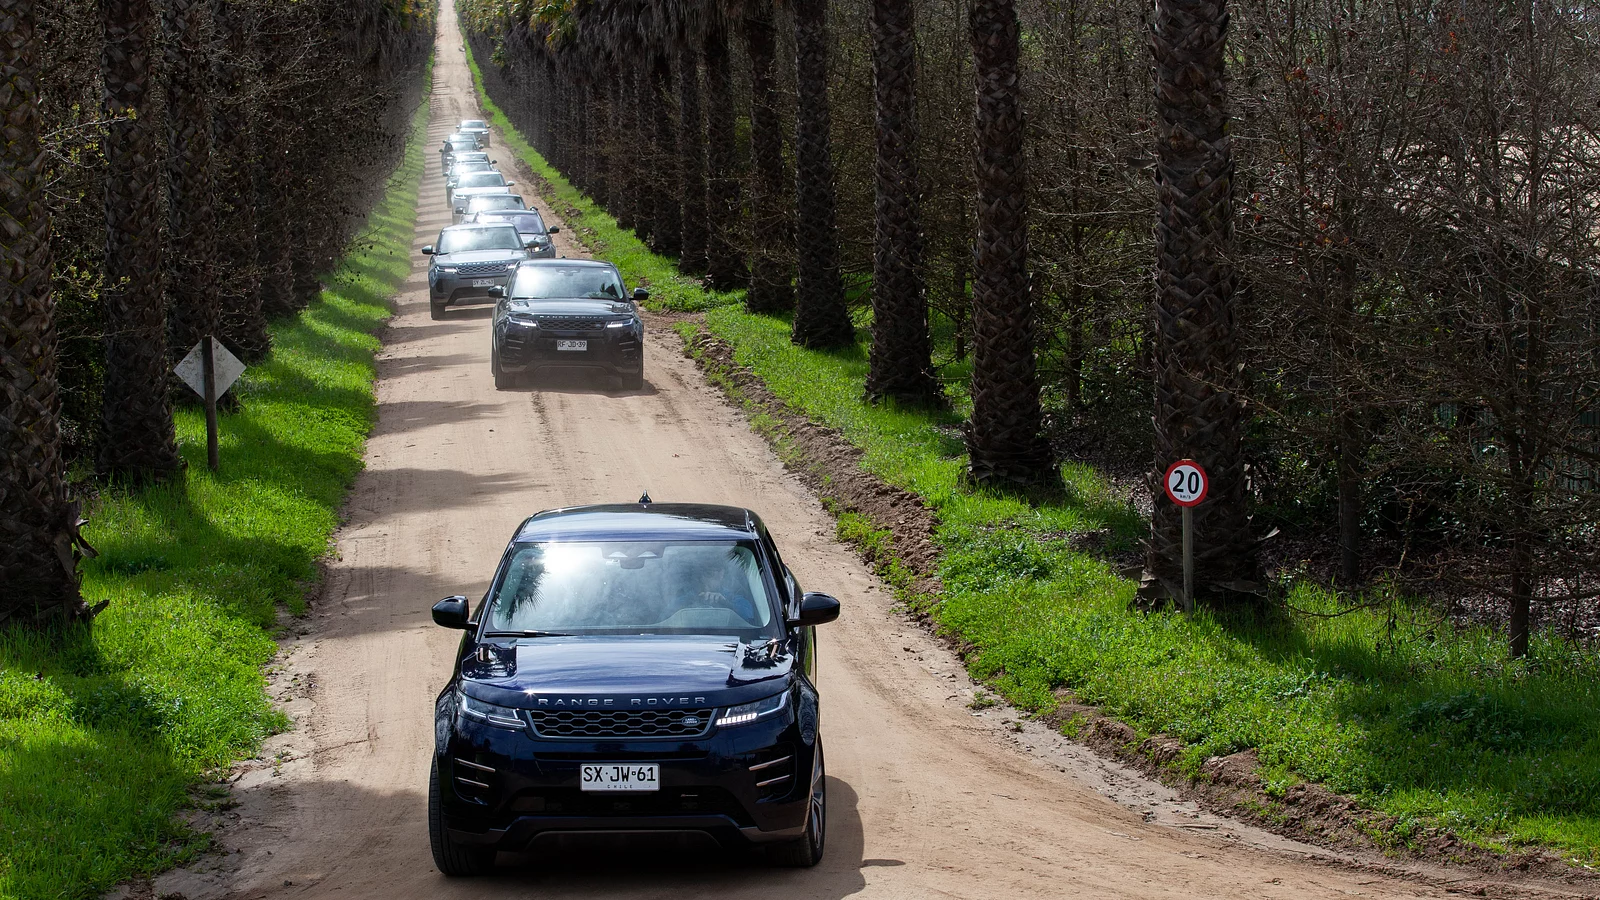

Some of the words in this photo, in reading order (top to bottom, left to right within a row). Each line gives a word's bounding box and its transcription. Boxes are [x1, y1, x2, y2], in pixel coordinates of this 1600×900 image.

[1172, 469, 1200, 495] 20
[538, 698, 614, 706] RANGE
[630, 696, 706, 706] ROVER
